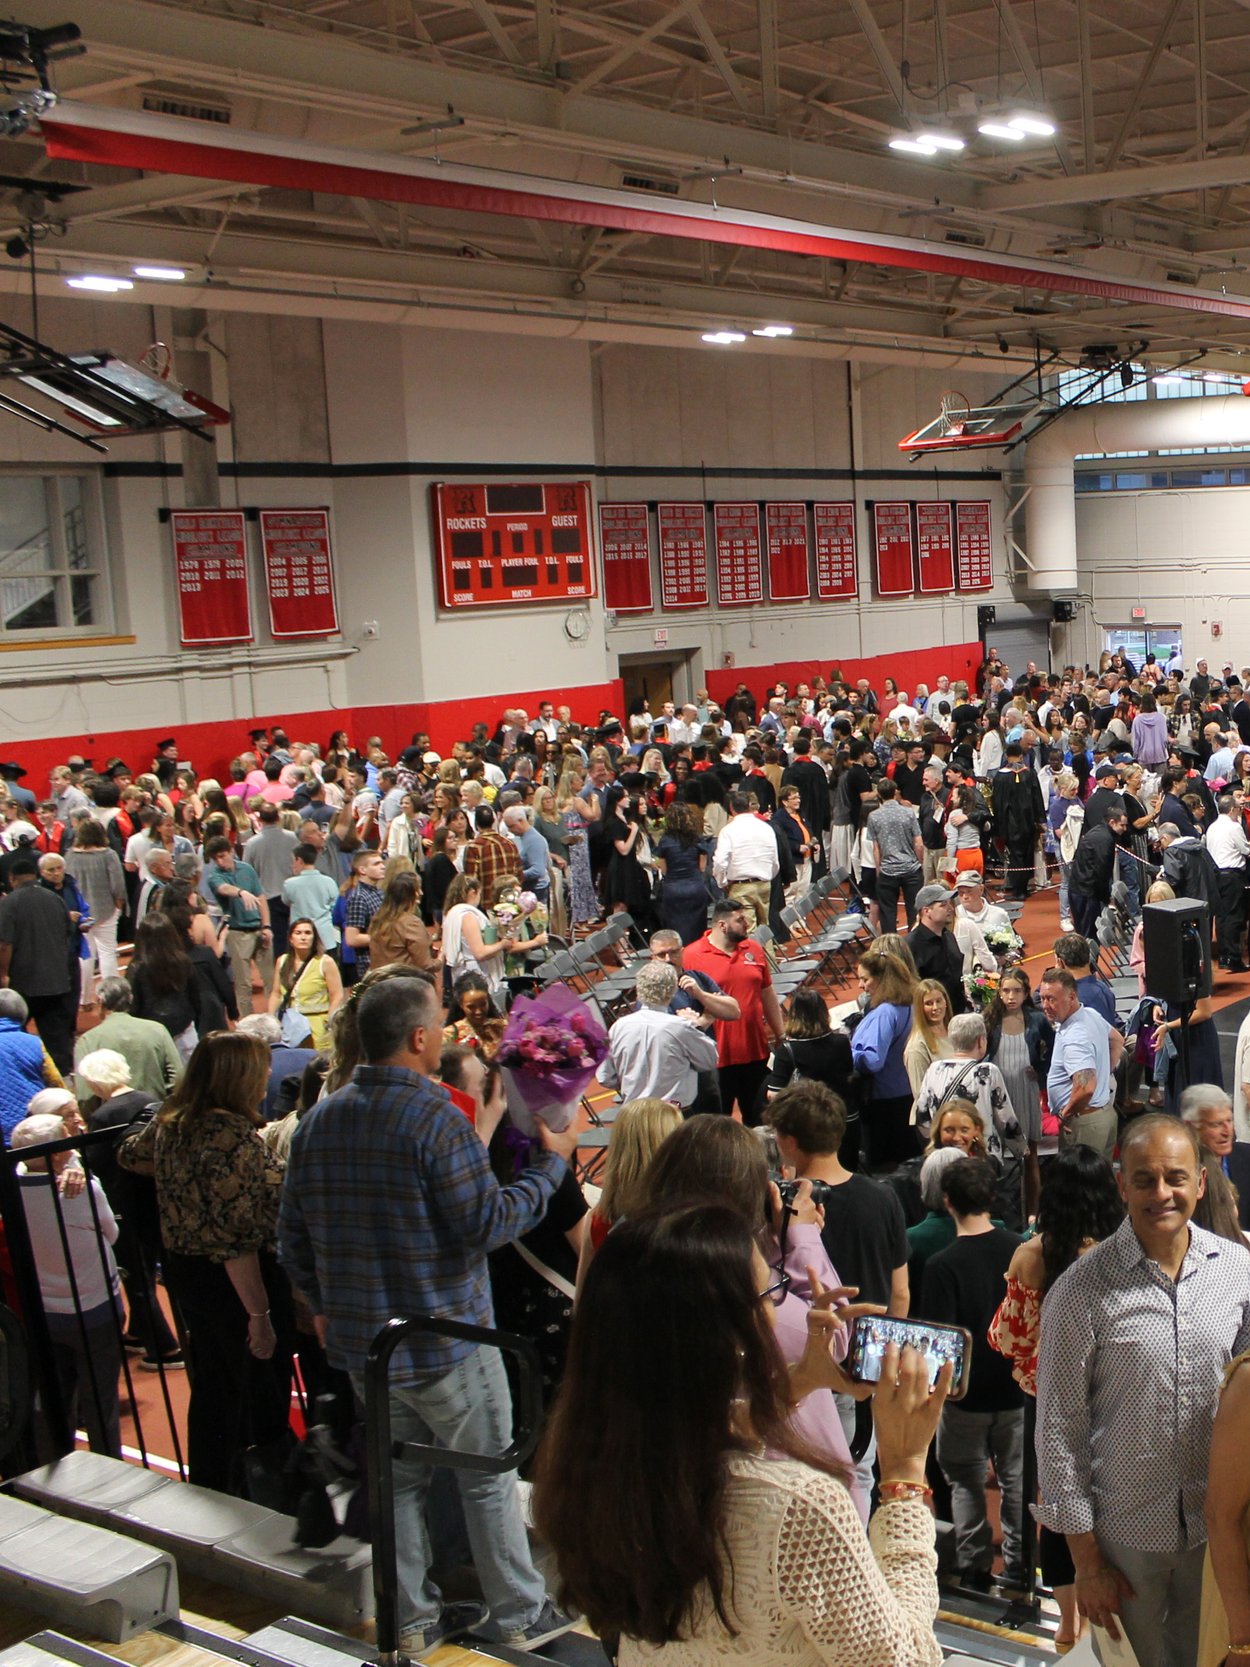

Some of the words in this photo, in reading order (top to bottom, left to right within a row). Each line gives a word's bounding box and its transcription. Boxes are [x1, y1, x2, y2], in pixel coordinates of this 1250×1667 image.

[446, 518, 487, 530] ROCKETS
[552, 515, 578, 526] GUEST
[507, 523, 528, 531] PERIOD
[501, 558, 523, 567] PLAYER
[524, 557, 539, 565] FOUL
[566, 555, 584, 563] FOULS
[452, 560, 472, 569] FOULS
[512, 590, 531, 598] MATCH
[568, 586, 586, 595] SCORE
[454, 593, 473, 602] SCORE
